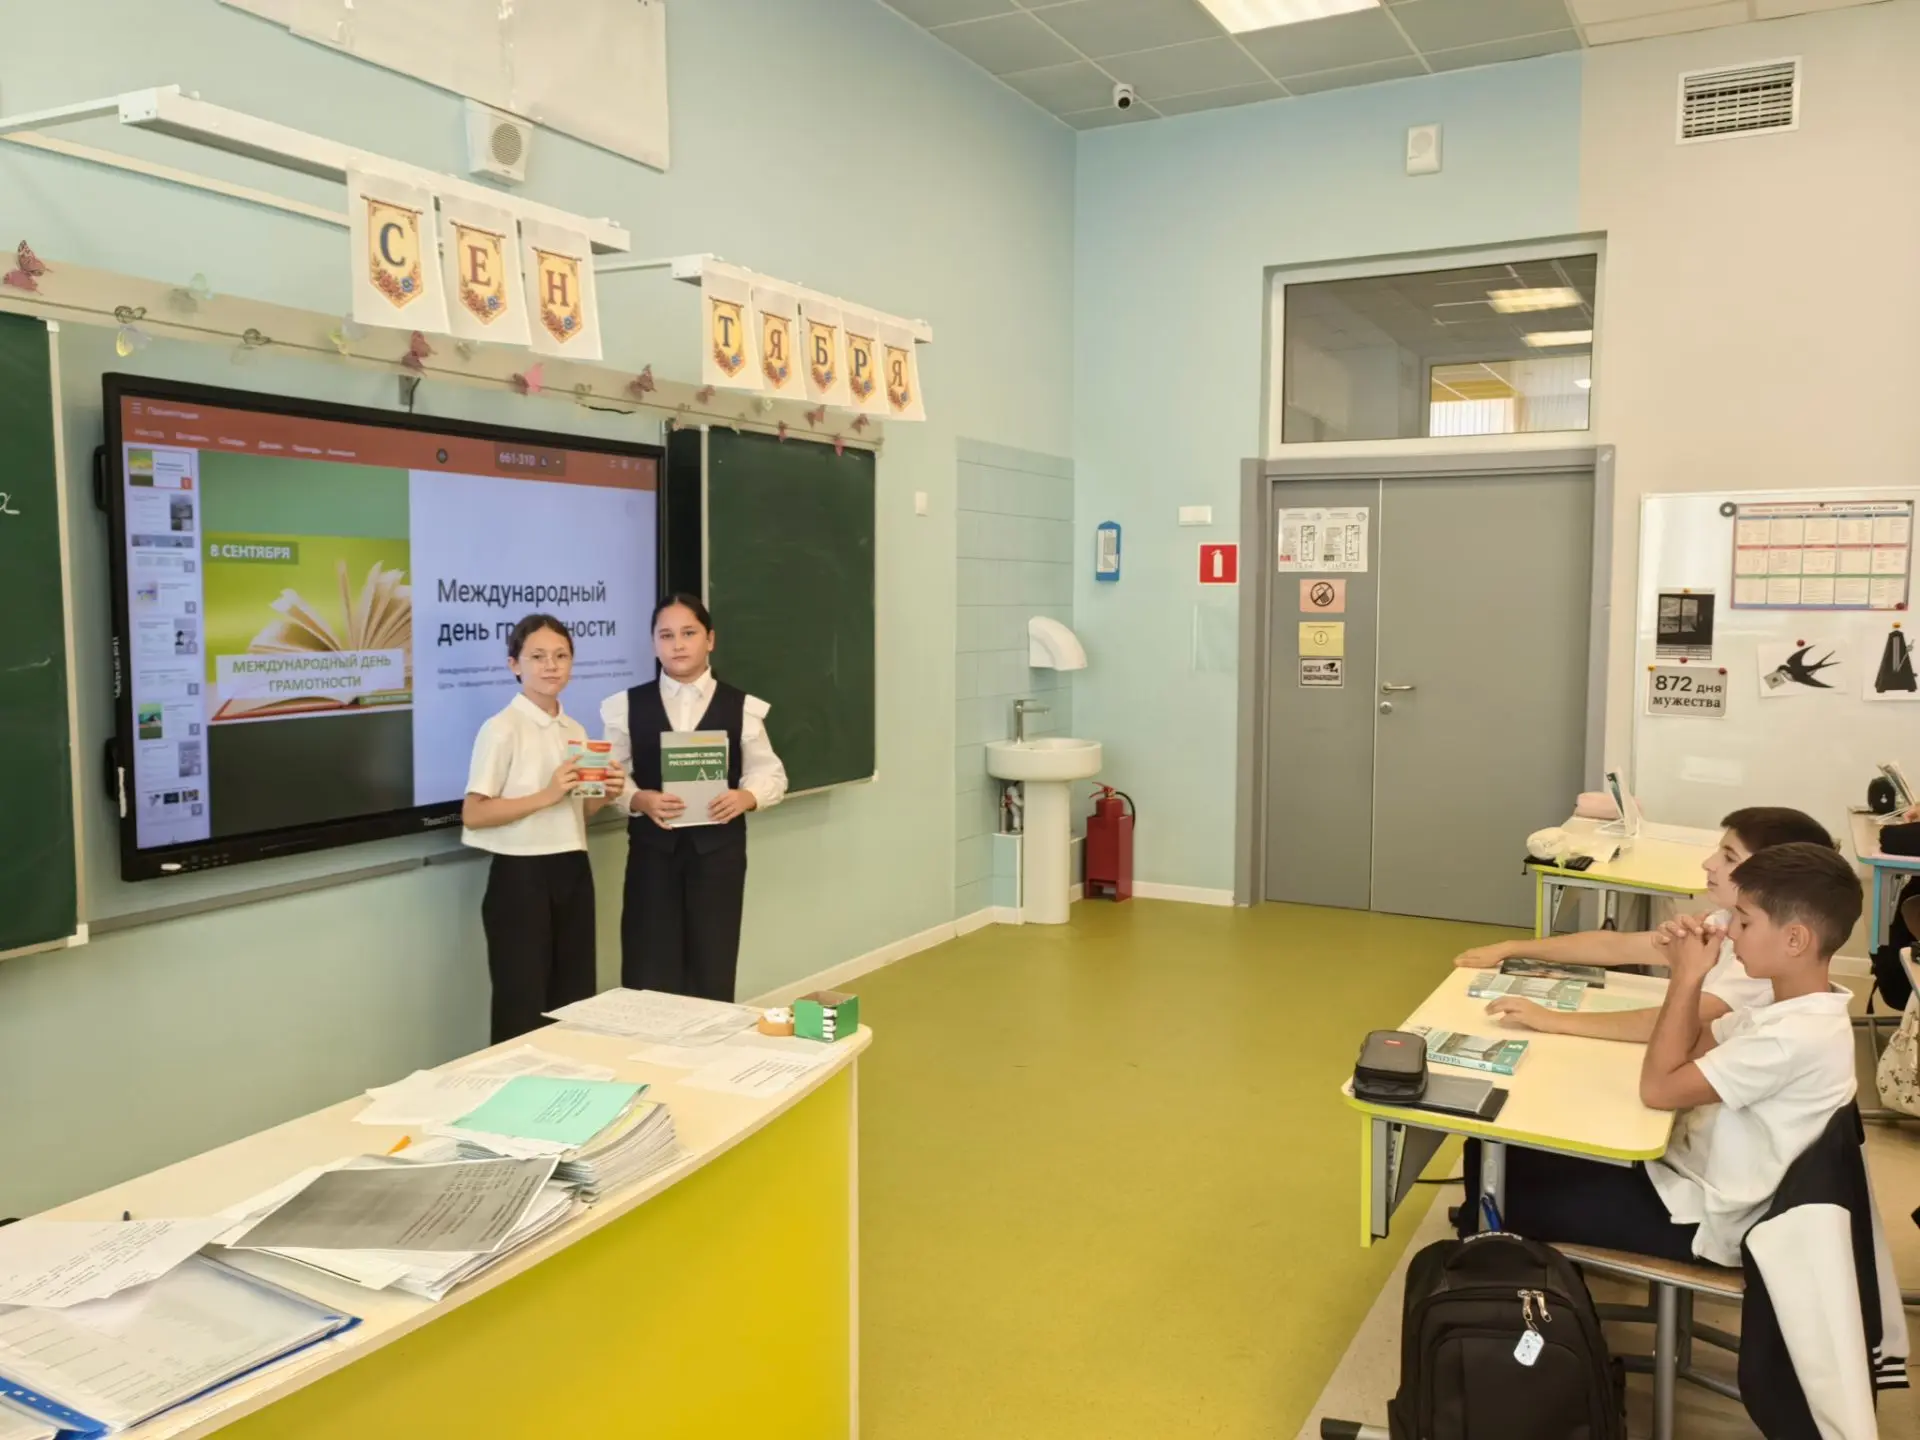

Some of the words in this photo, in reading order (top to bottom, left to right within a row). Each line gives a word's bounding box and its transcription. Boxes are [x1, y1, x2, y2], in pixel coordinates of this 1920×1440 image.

[222, 544, 290, 559] СЕНТЯБРЯ
[437, 578, 607, 608] Международный
[437, 622, 490, 646] день
[232, 654, 358, 674] МЕЖДУНАРОДНЫЙ
[361, 655, 391, 669] ДЕНЬ
[269, 676, 361, 693] ГРАМОТНОСТИ
[1655, 675, 1692, 692] 872
[1696, 684, 1722, 694] дня
[1652, 696, 1721, 708] мужества
[696, 767, 724, 781] А-Я
